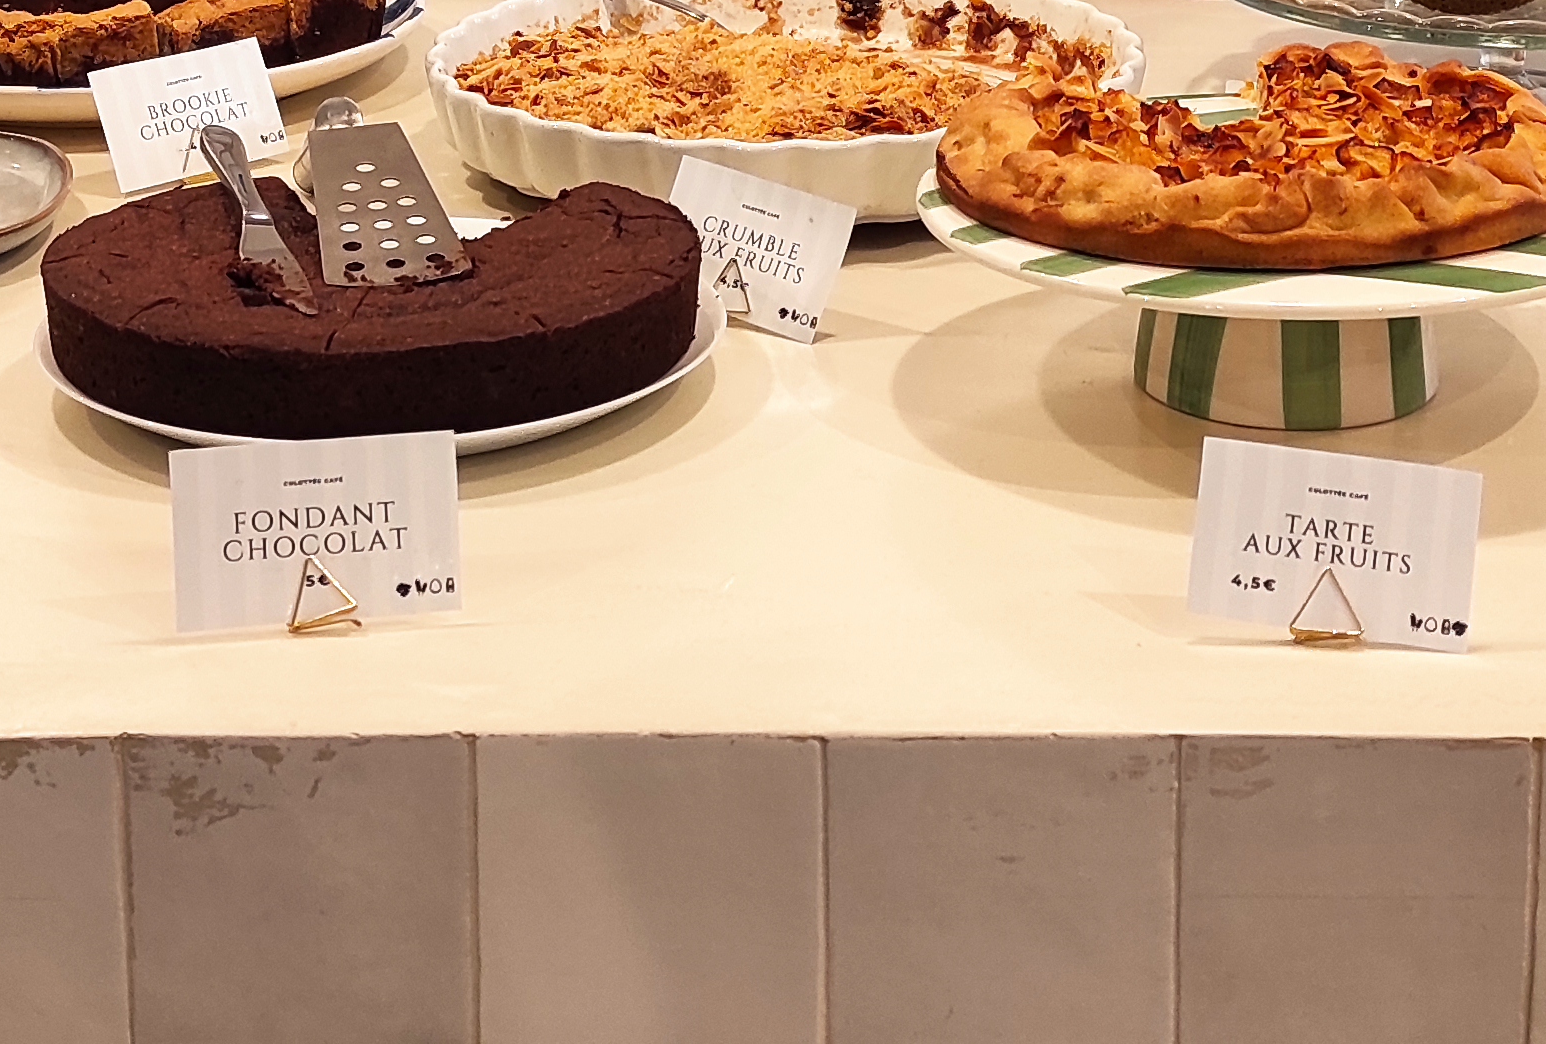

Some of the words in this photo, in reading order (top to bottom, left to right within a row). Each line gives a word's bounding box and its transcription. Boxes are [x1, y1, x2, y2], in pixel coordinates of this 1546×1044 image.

[139, 101, 249, 141] CHOCOLAT
[147, 87, 234, 121] BROOKIE
[703, 216, 801, 261] CRUMBLE
[702, 235, 729, 260] UX
[735, 246, 805, 284] FRUITS
[233, 501, 395, 534] FONDANT
[1285, 513, 1375, 545] TARTE
[223, 527, 408, 563] CHOCOLAT
[1242, 533, 1302, 560] AUX
[1313, 542, 1412, 575] FRUITS
[1230, 574, 1276, 592] 4,5€
